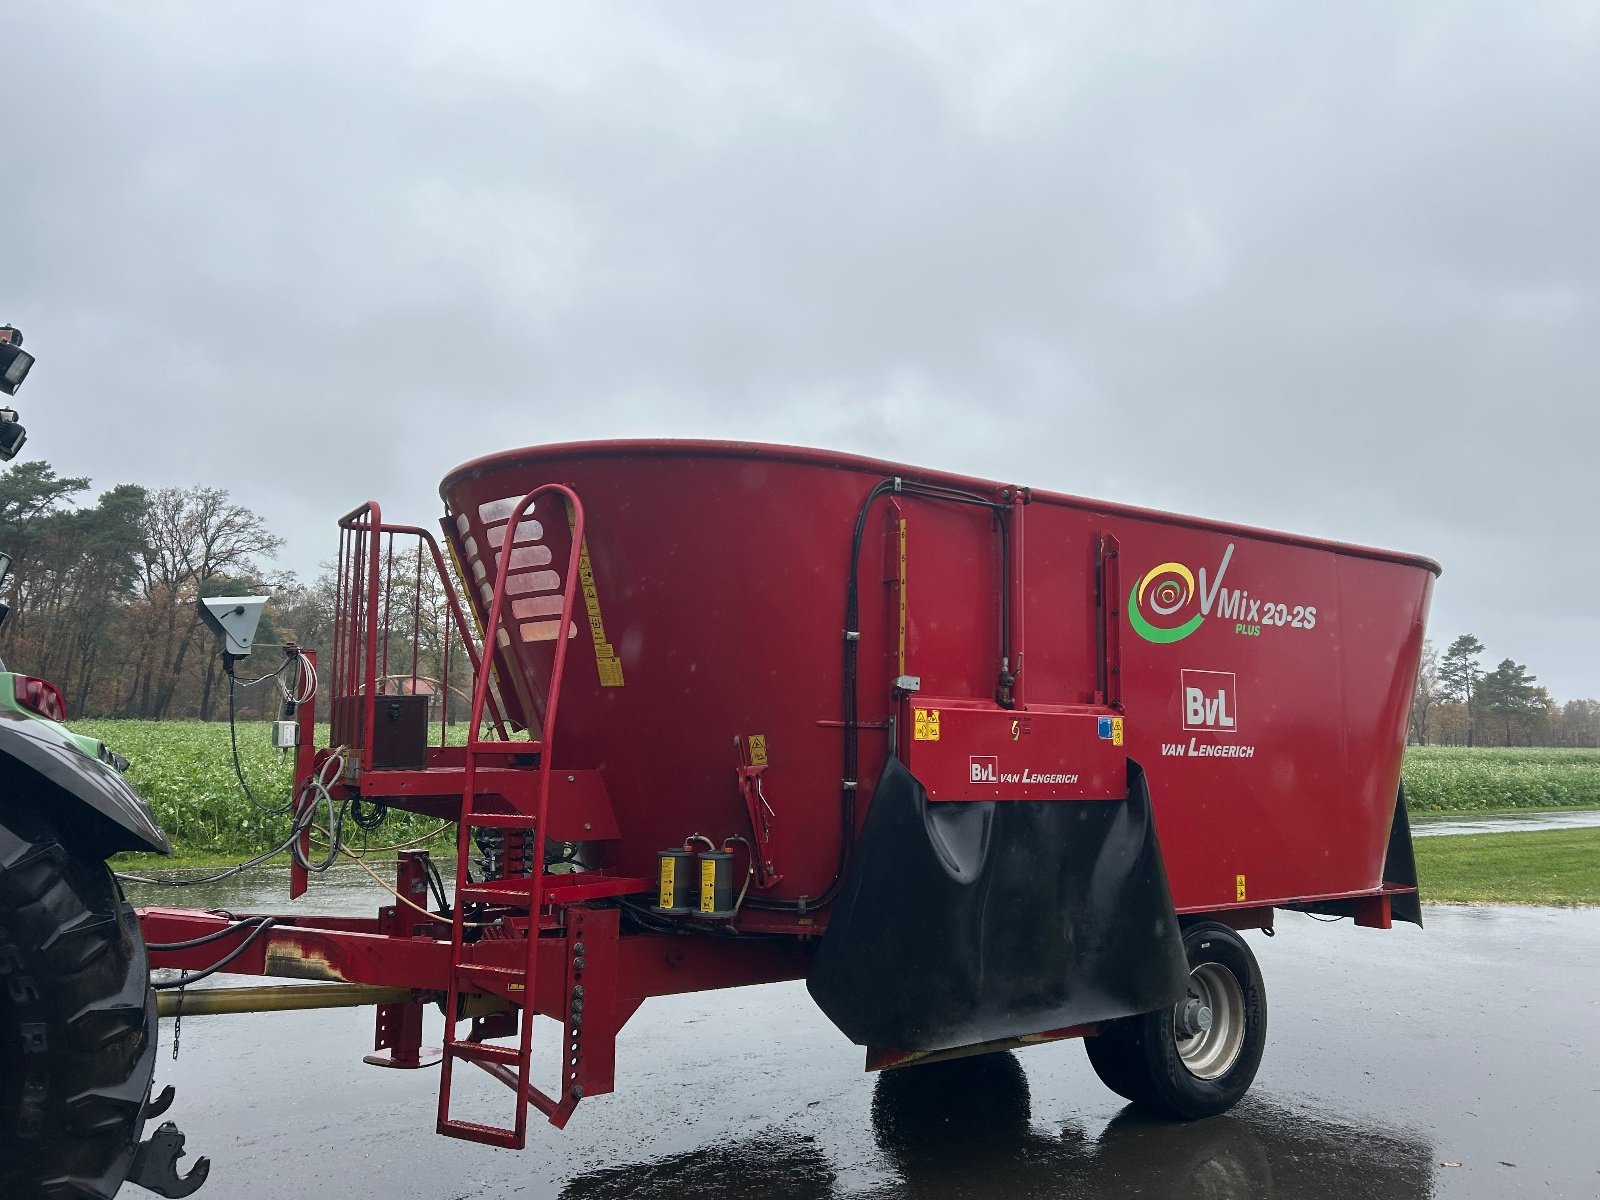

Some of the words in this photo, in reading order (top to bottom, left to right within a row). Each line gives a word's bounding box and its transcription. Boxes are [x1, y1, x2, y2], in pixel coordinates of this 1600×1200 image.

[1262, 602, 1317, 629] 20-2S
[1235, 623, 1261, 637] PLUS
[1186, 687, 1234, 727] BvL
[1161, 743, 1186, 756] VAN
[971, 763, 996, 781] BvL
[1000, 773, 1020, 783] VAN
